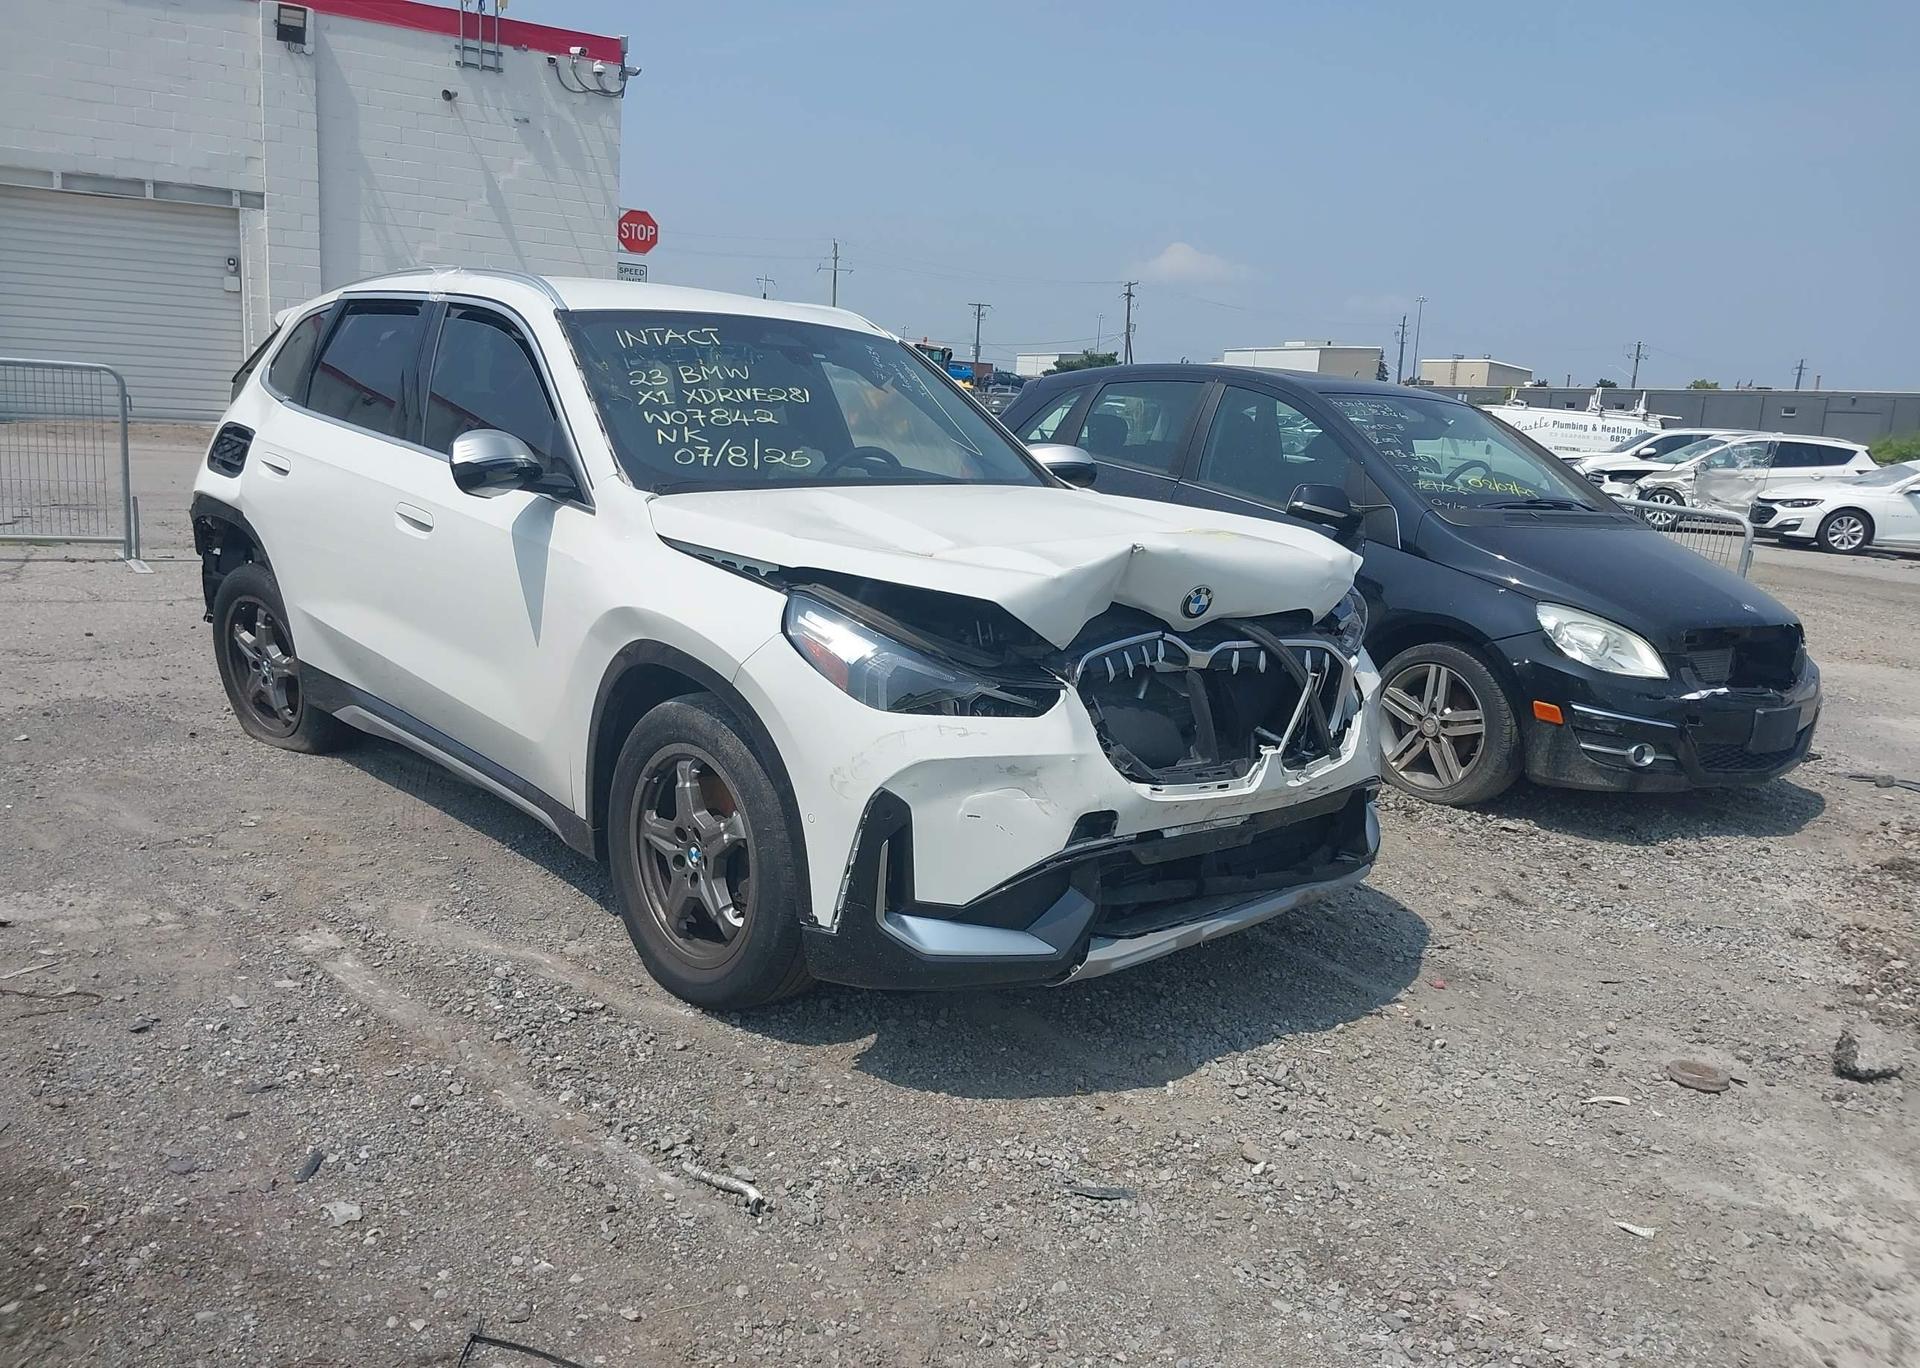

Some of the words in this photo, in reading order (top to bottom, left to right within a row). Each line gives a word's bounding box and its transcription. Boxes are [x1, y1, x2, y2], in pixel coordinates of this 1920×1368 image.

[620, 222, 656, 242] STOP
[619, 266, 645, 276] SPEED
[615, 327, 721, 348] INTACT
[629, 369, 668, 386] 23
[678, 365, 750, 384] BMW
[638, 389, 675, 406] X1
[656, 426, 709, 445] NK
[1552, 420, 1588, 433] Plumbing
[1592, 424, 1599, 432] &
[1601, 424, 1632, 436] Heating
